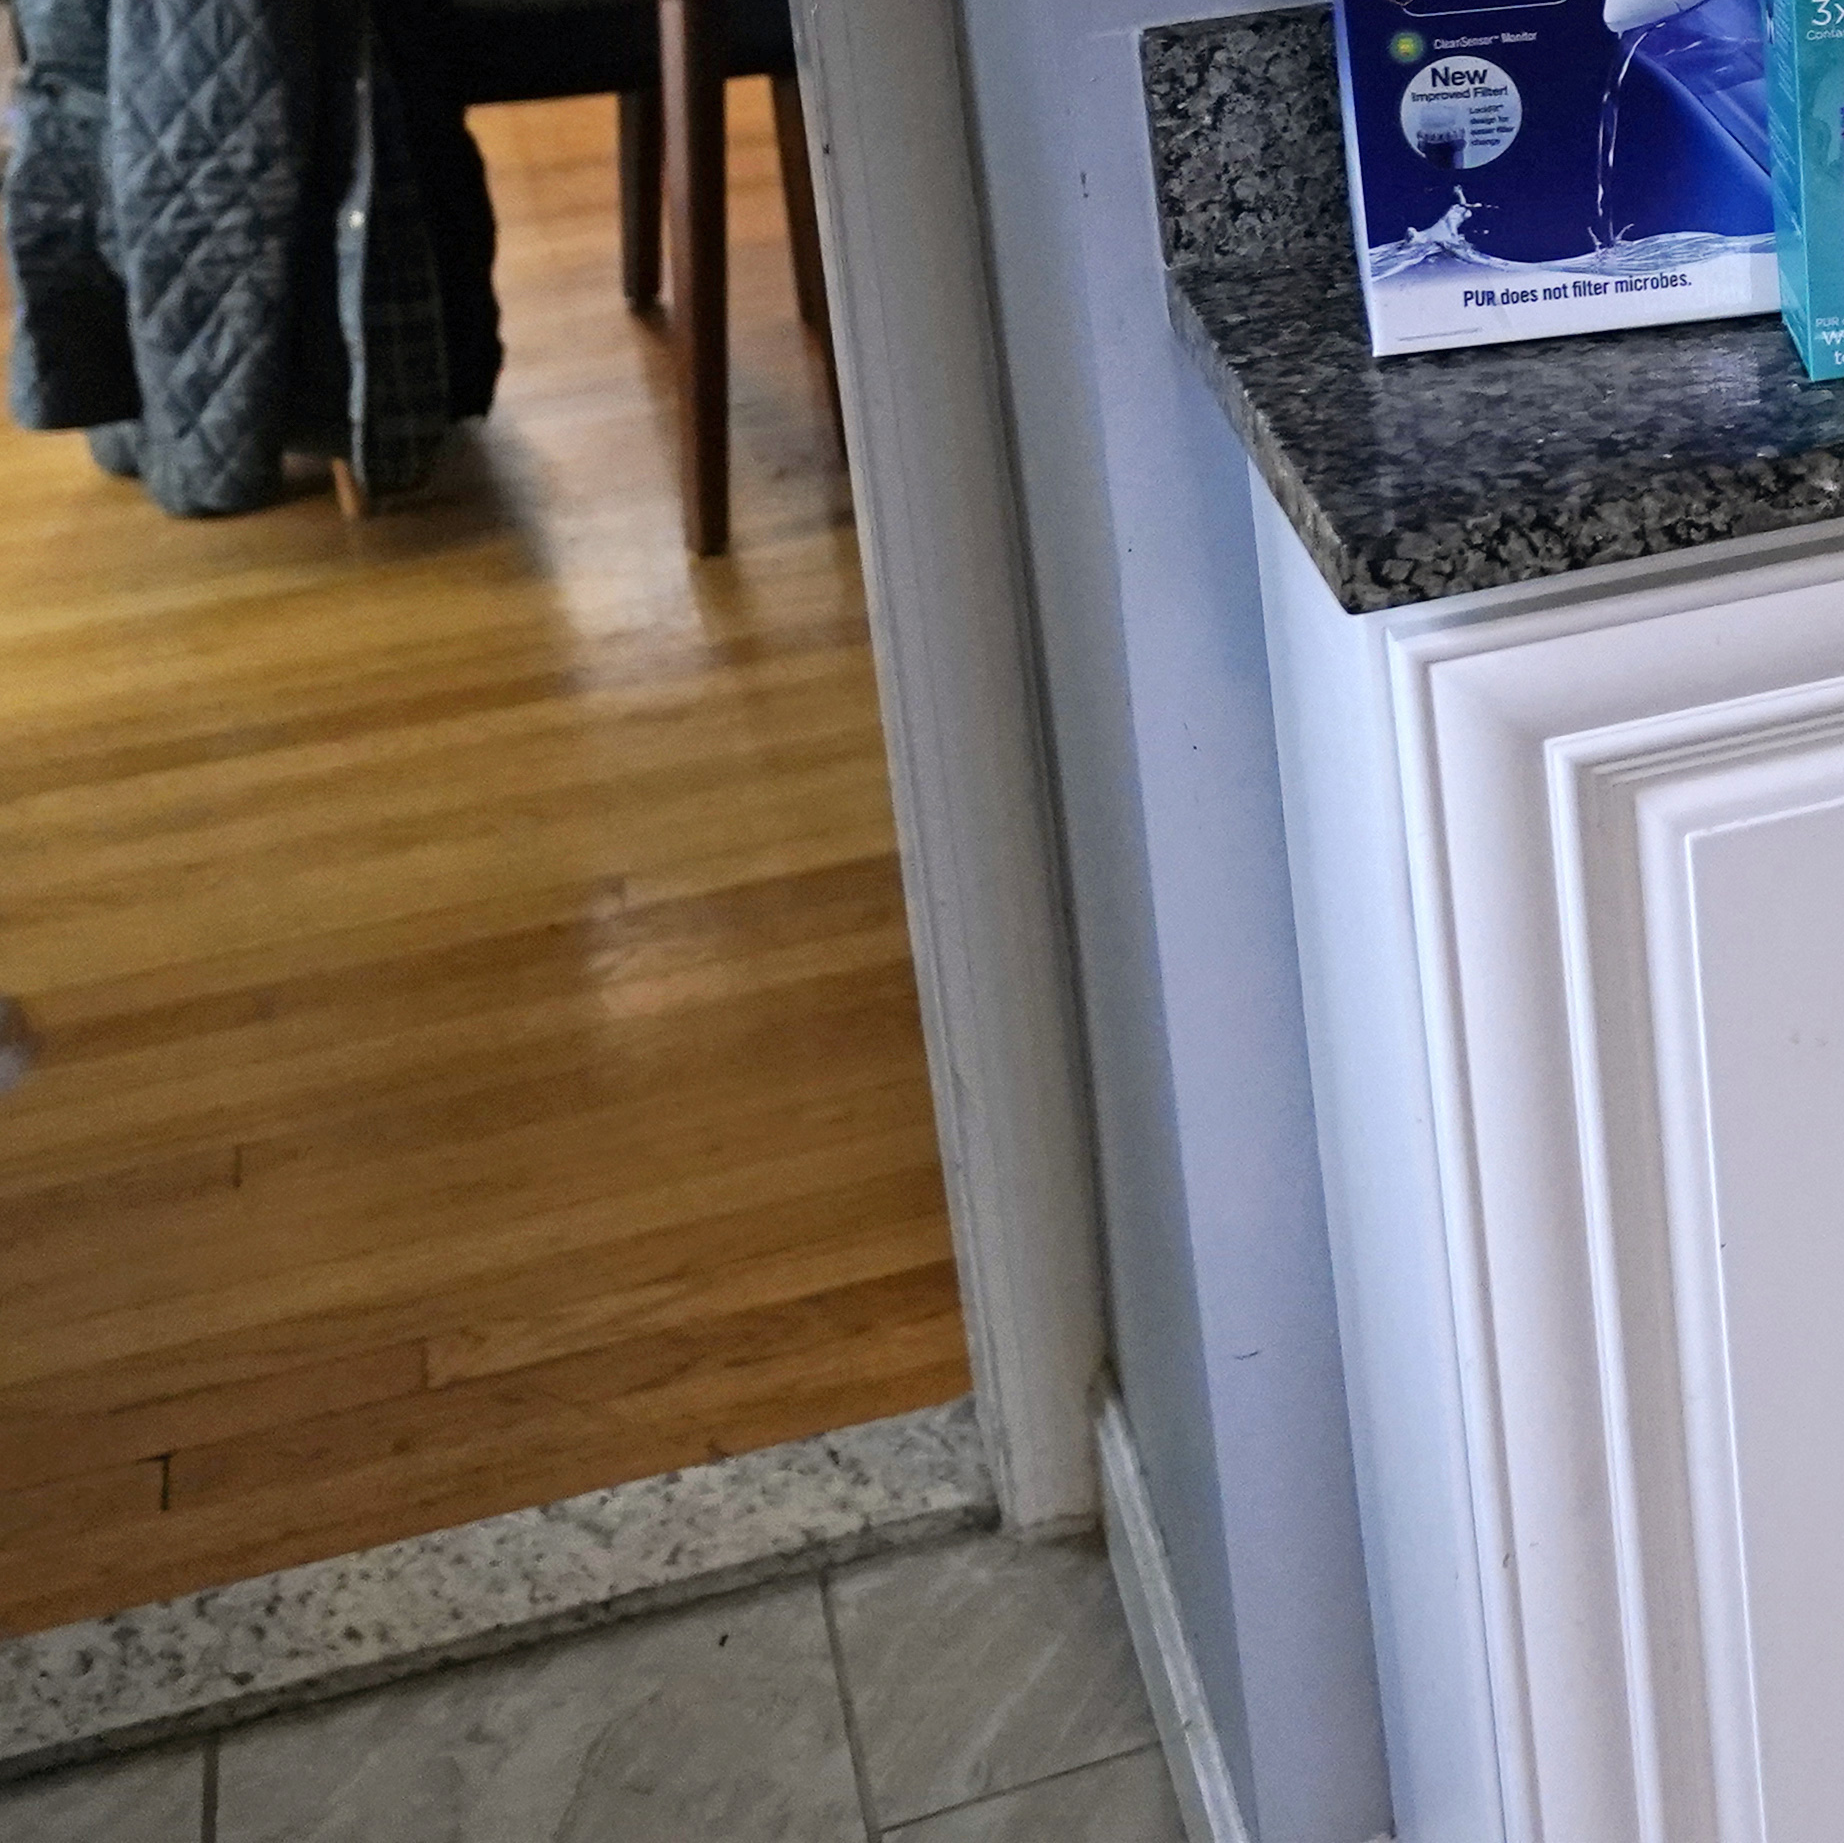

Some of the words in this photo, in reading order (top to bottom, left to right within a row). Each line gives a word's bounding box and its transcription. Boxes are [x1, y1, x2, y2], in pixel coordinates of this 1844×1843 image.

[1431, 66, 1488, 87] New
[1411, 87, 1470, 103] Improved
[1463, 289, 1496, 307] PUR
[1501, 288, 1539, 305] does
[1543, 284, 1569, 301] not
[1573, 280, 1610, 298] filter
[1615, 272, 1692, 294] microbes.
[1815, 317, 1839, 328] PUR
